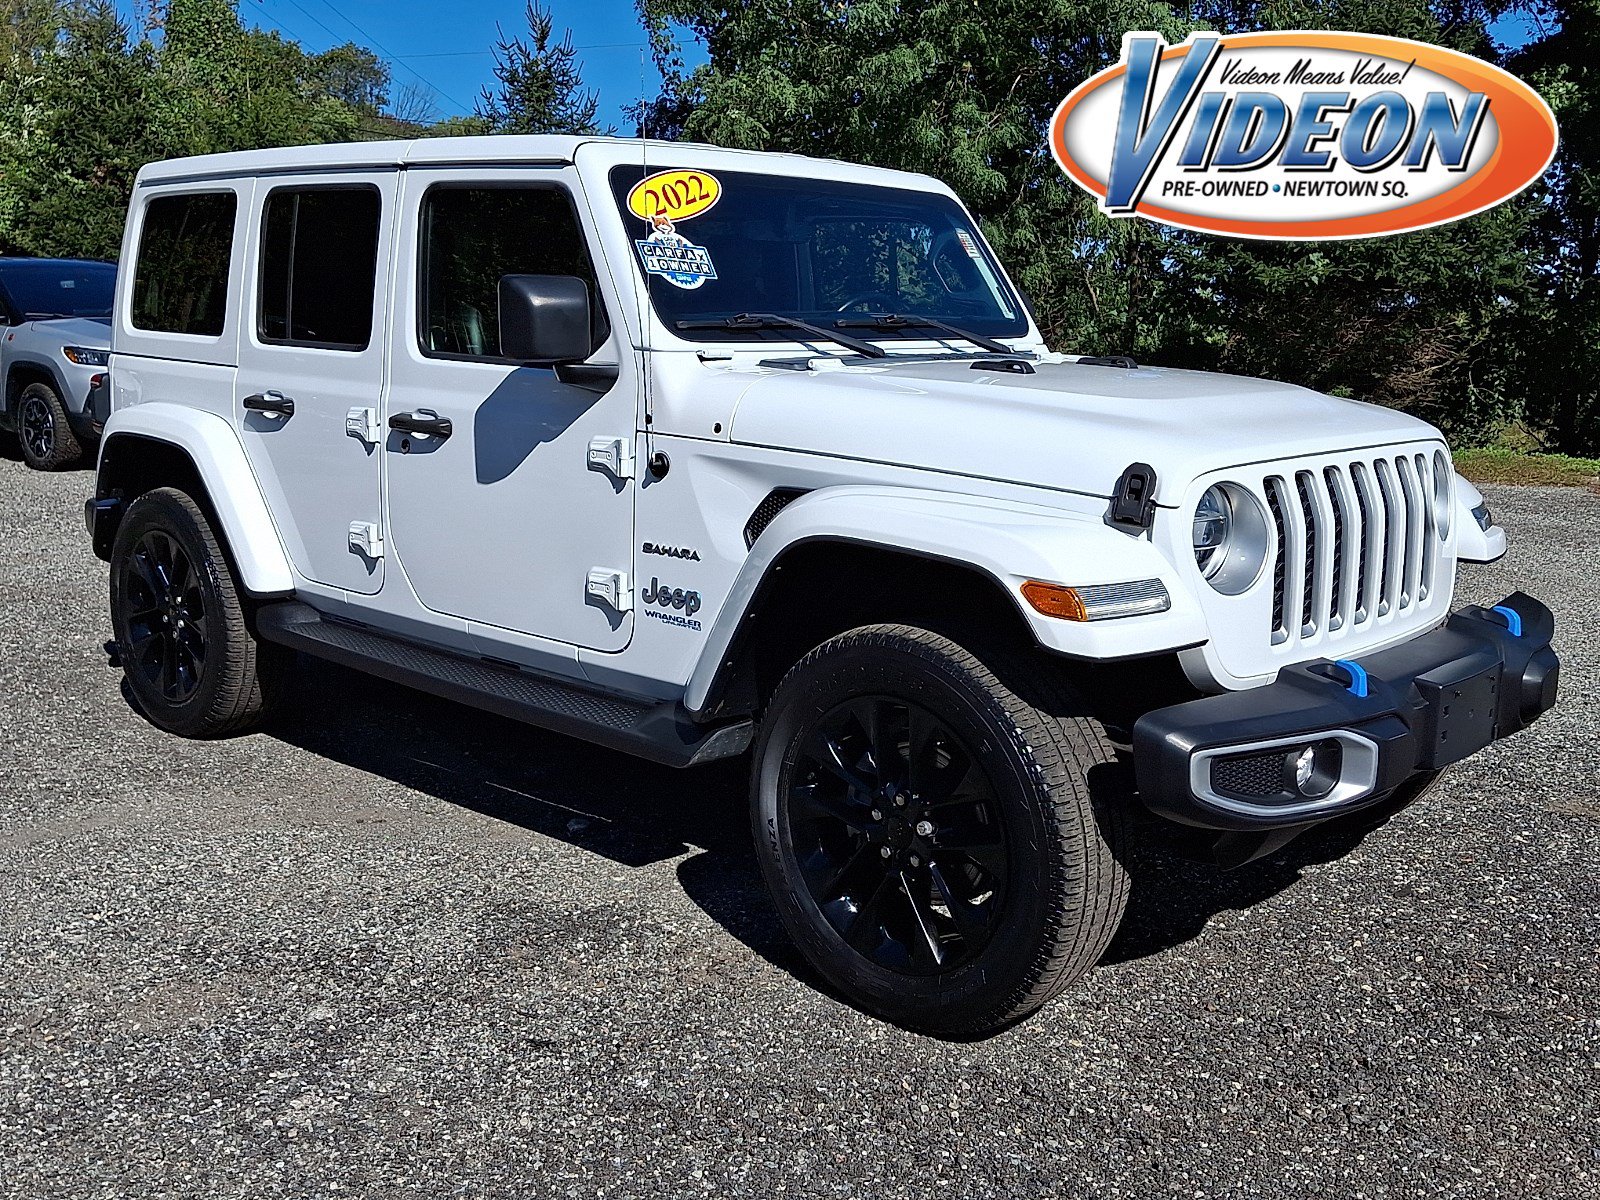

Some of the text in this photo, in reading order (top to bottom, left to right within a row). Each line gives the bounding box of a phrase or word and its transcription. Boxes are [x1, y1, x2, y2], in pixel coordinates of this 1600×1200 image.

[645, 175, 711, 216] 2022
[642, 245, 705, 262] CARFAX
[659, 260, 711, 274] OWNER
[642, 542, 701, 562] SAHARA
[642, 577, 702, 616] Jeep
[644, 609, 702, 628] WRANGLER
